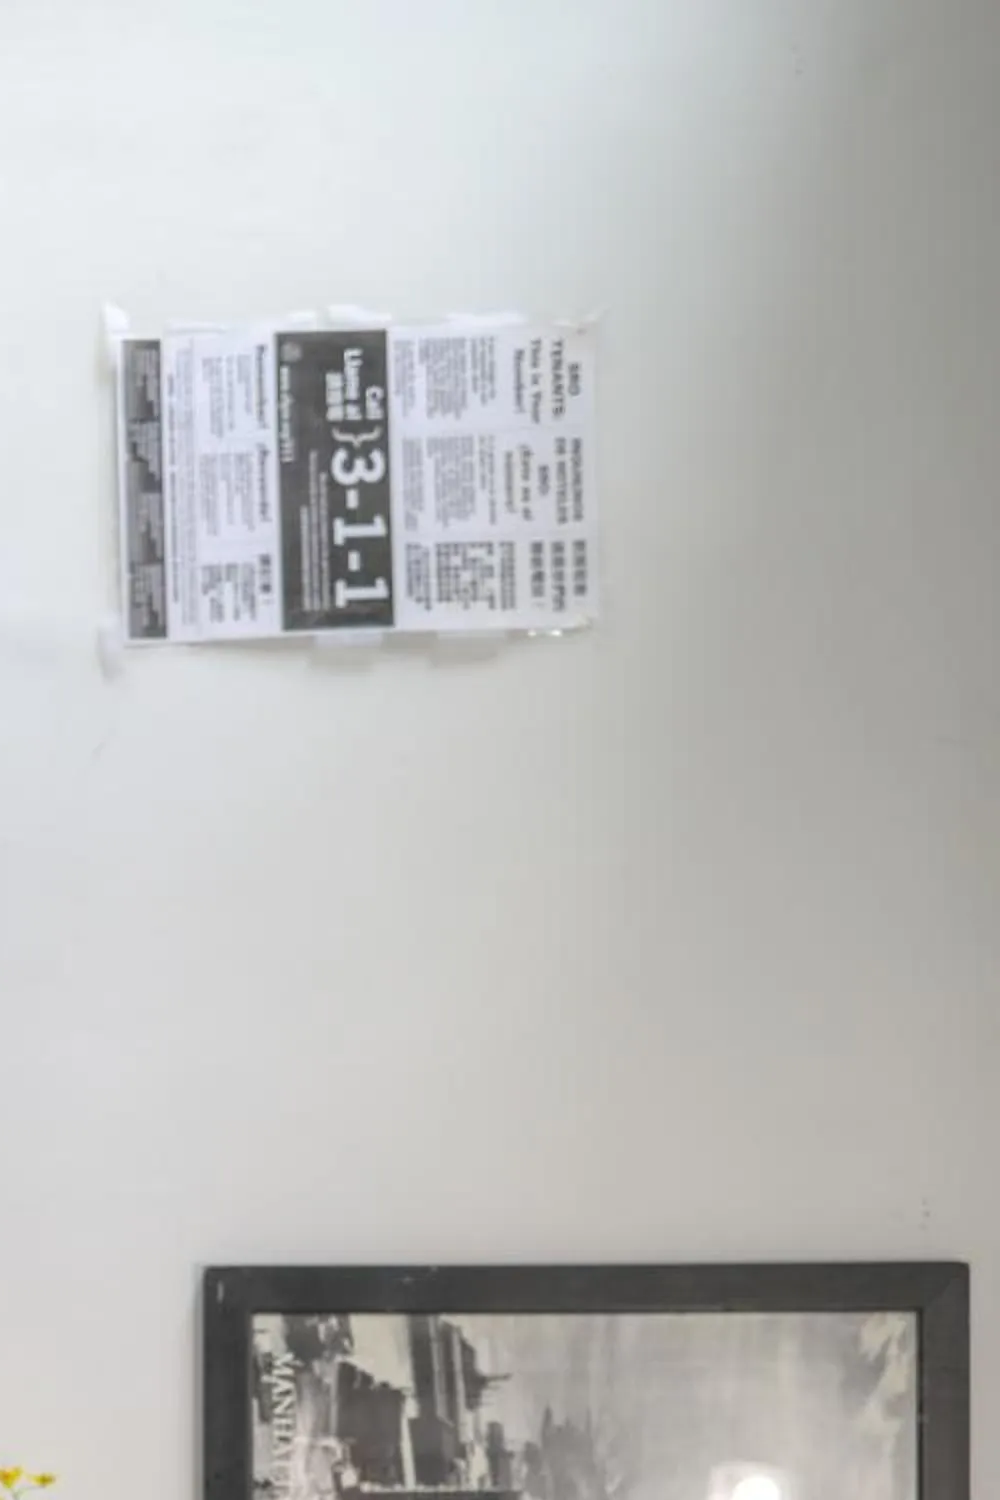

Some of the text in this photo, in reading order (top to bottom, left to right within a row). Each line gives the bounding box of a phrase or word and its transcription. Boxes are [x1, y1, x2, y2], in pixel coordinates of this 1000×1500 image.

[344, 349, 362, 420] Llame al
[366, 386, 383, 420] Call
[330, 449, 390, 608] 3-1-1
